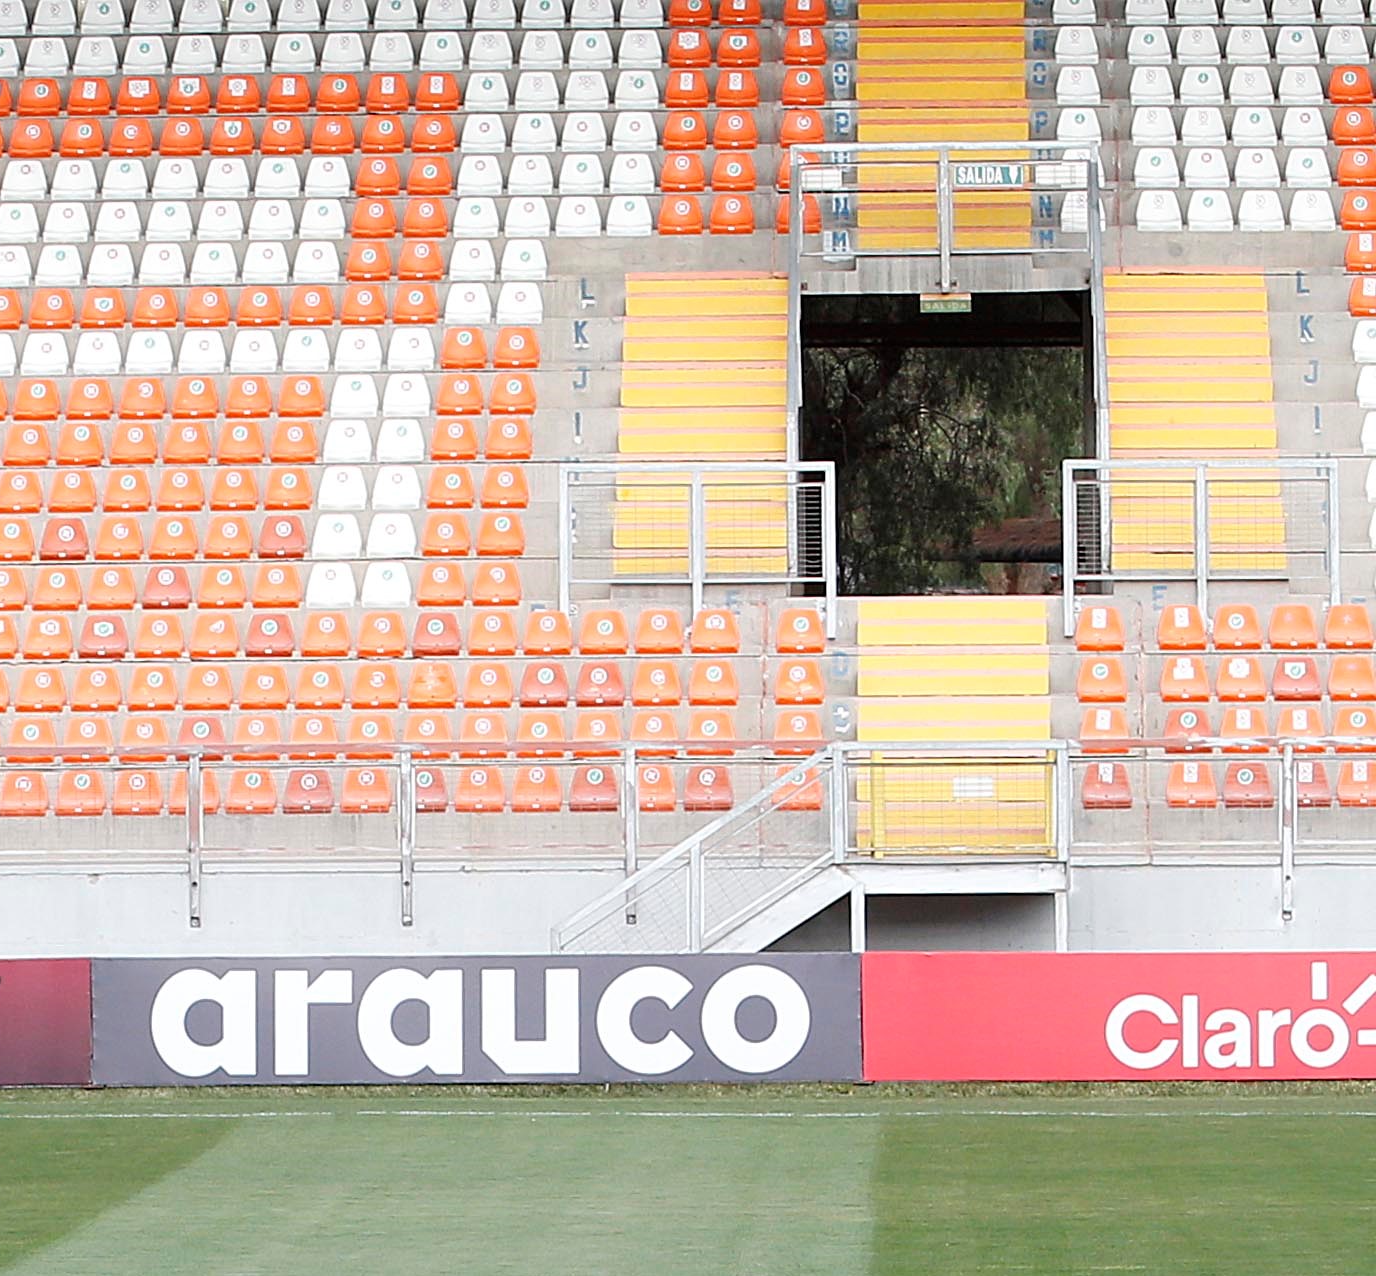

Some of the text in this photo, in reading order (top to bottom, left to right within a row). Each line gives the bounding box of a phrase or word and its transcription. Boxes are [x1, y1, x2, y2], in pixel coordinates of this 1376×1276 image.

[957, 165, 1004, 184] SALIDA
[580, 277, 595, 300] L
[1296, 271, 1310, 293] L
[574, 320, 588, 344] K
[1300, 315, 1314, 339] K
[573, 366, 587, 389] J
[1304, 360, 1318, 383] J
[150, 963, 812, 1078] arauco
[1104, 993, 1351, 1070] Claro
